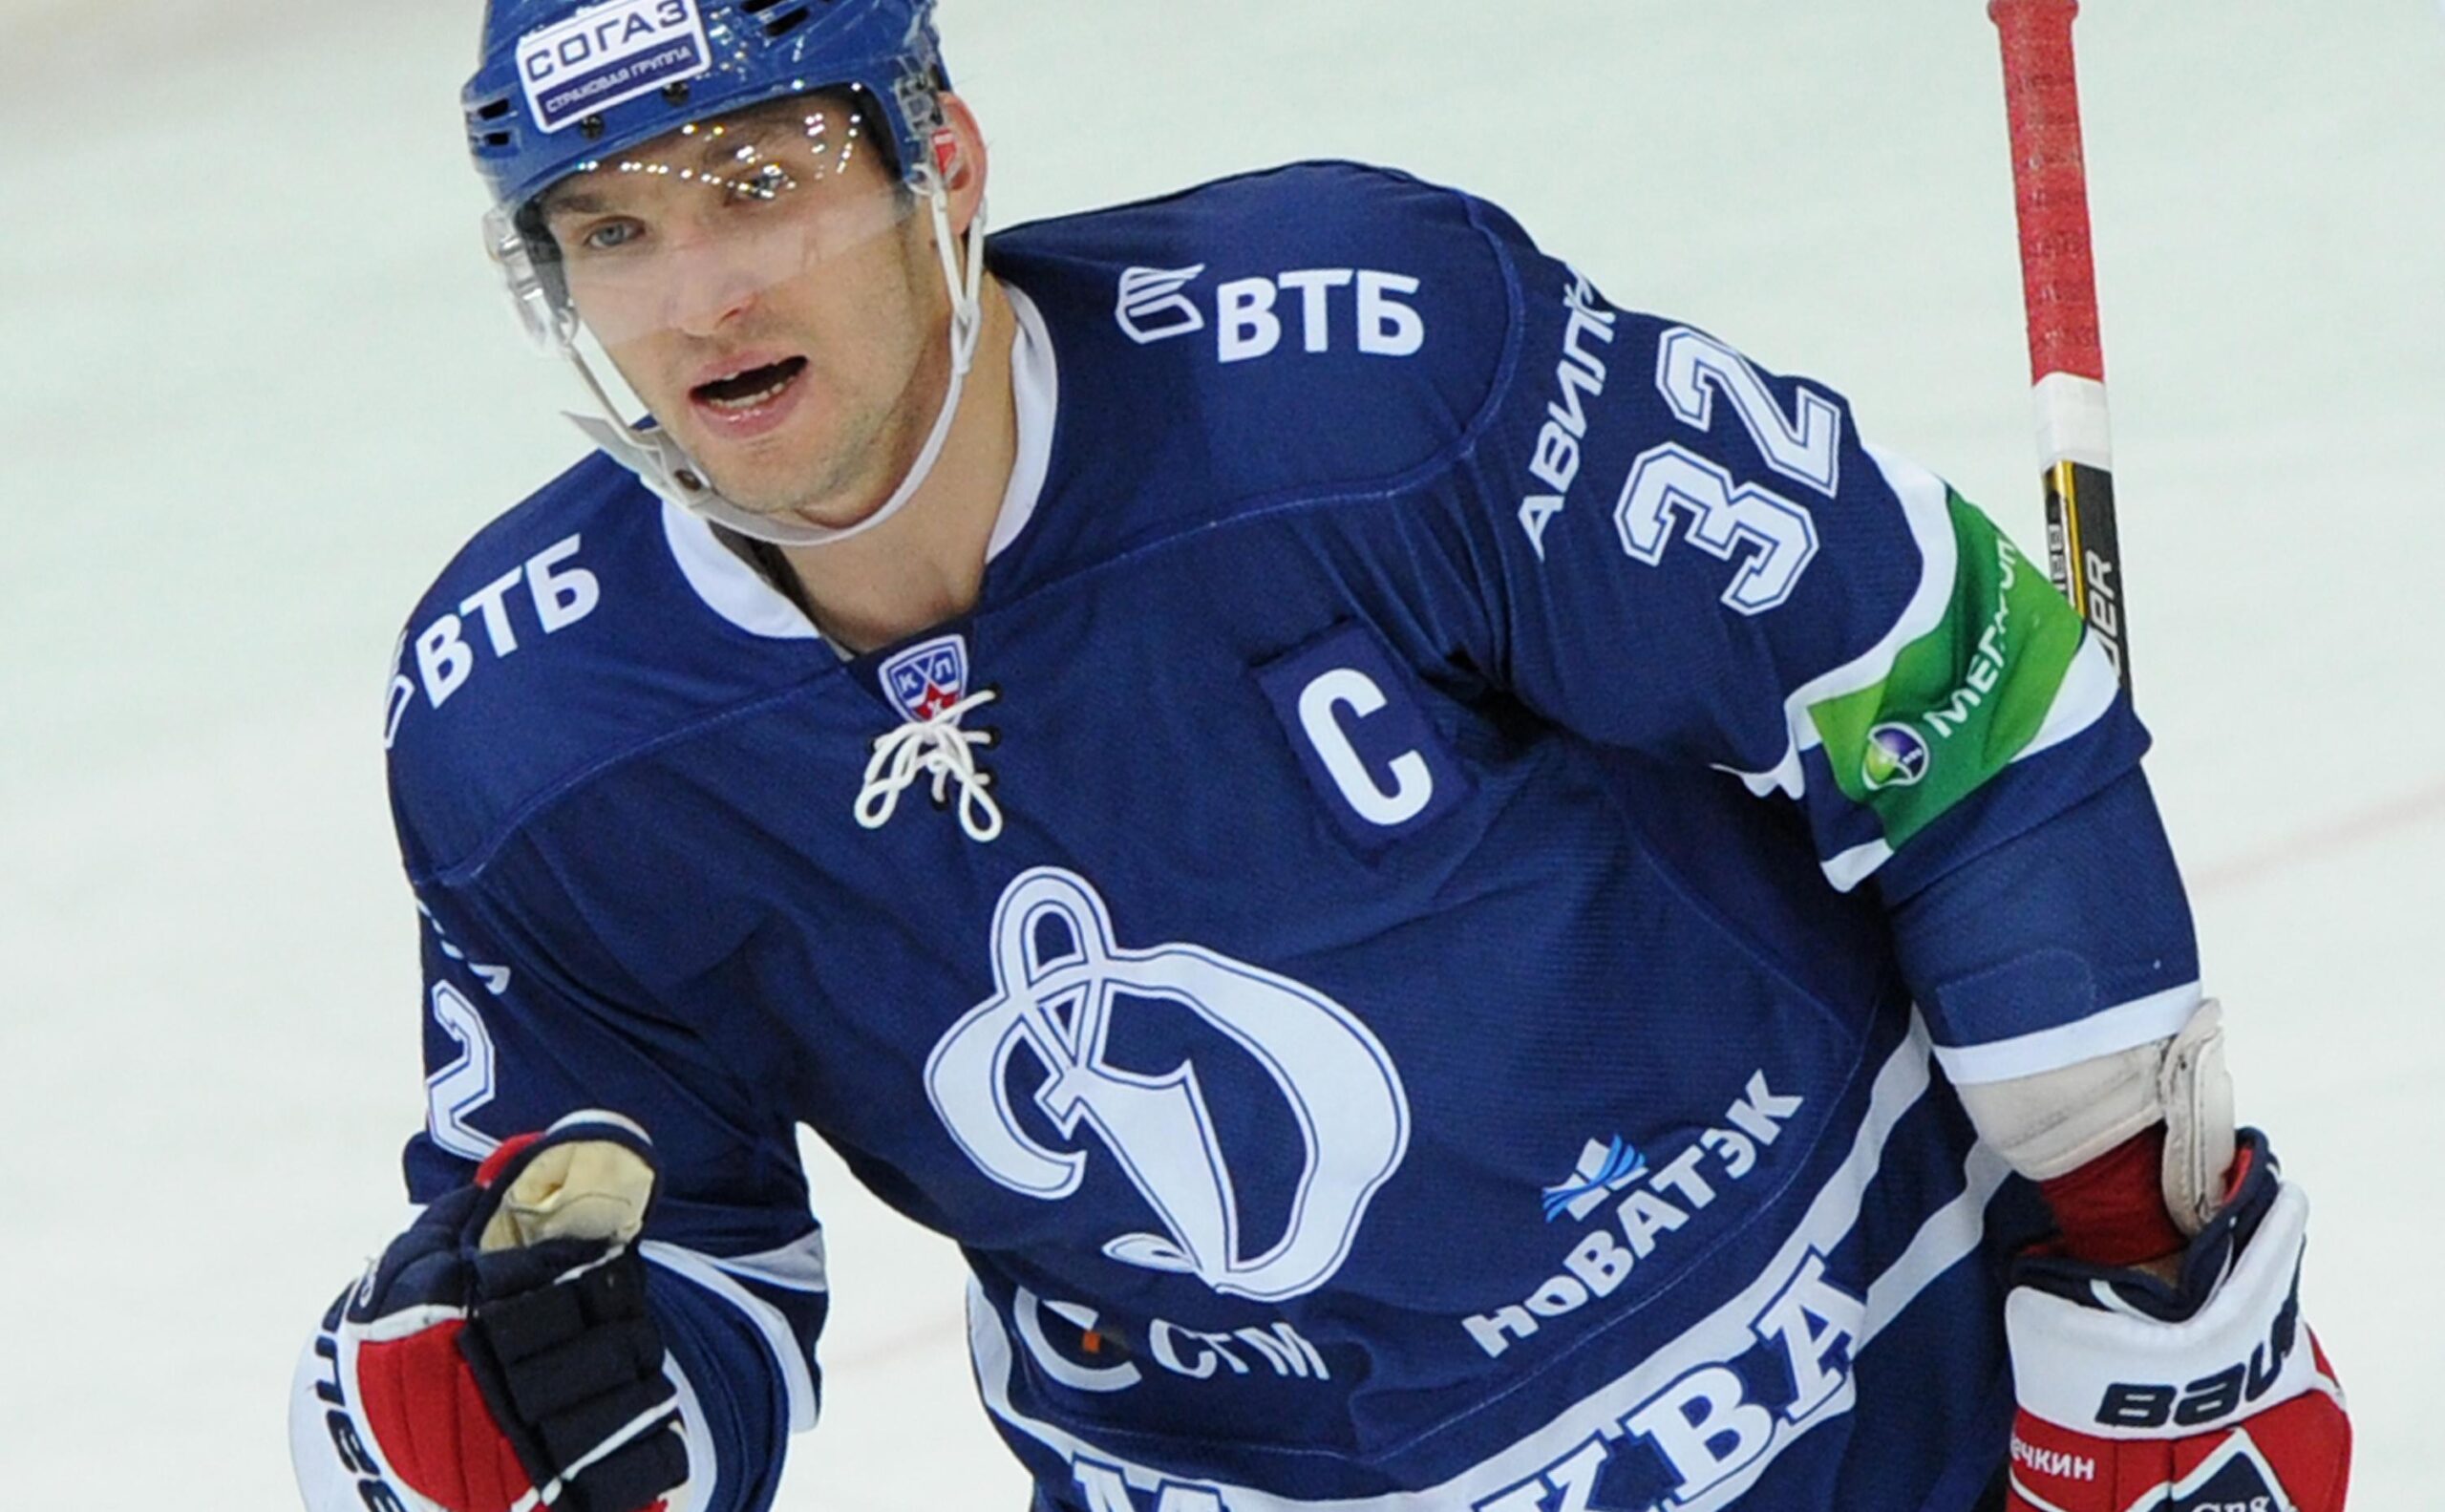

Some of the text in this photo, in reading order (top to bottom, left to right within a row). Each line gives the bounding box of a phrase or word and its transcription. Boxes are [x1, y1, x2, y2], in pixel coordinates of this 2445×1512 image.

[525, 0, 688, 82] СОГАЗ
[630, 46, 693, 78] ГРУППА
[1217, 267, 1424, 364] ВТБ
[1614, 325, 1841, 617] 32
[415, 532, 600, 710] ВТБ
[425, 979, 504, 1162] 2
[1461, 1067, 1805, 1359] НОВАТЭК
